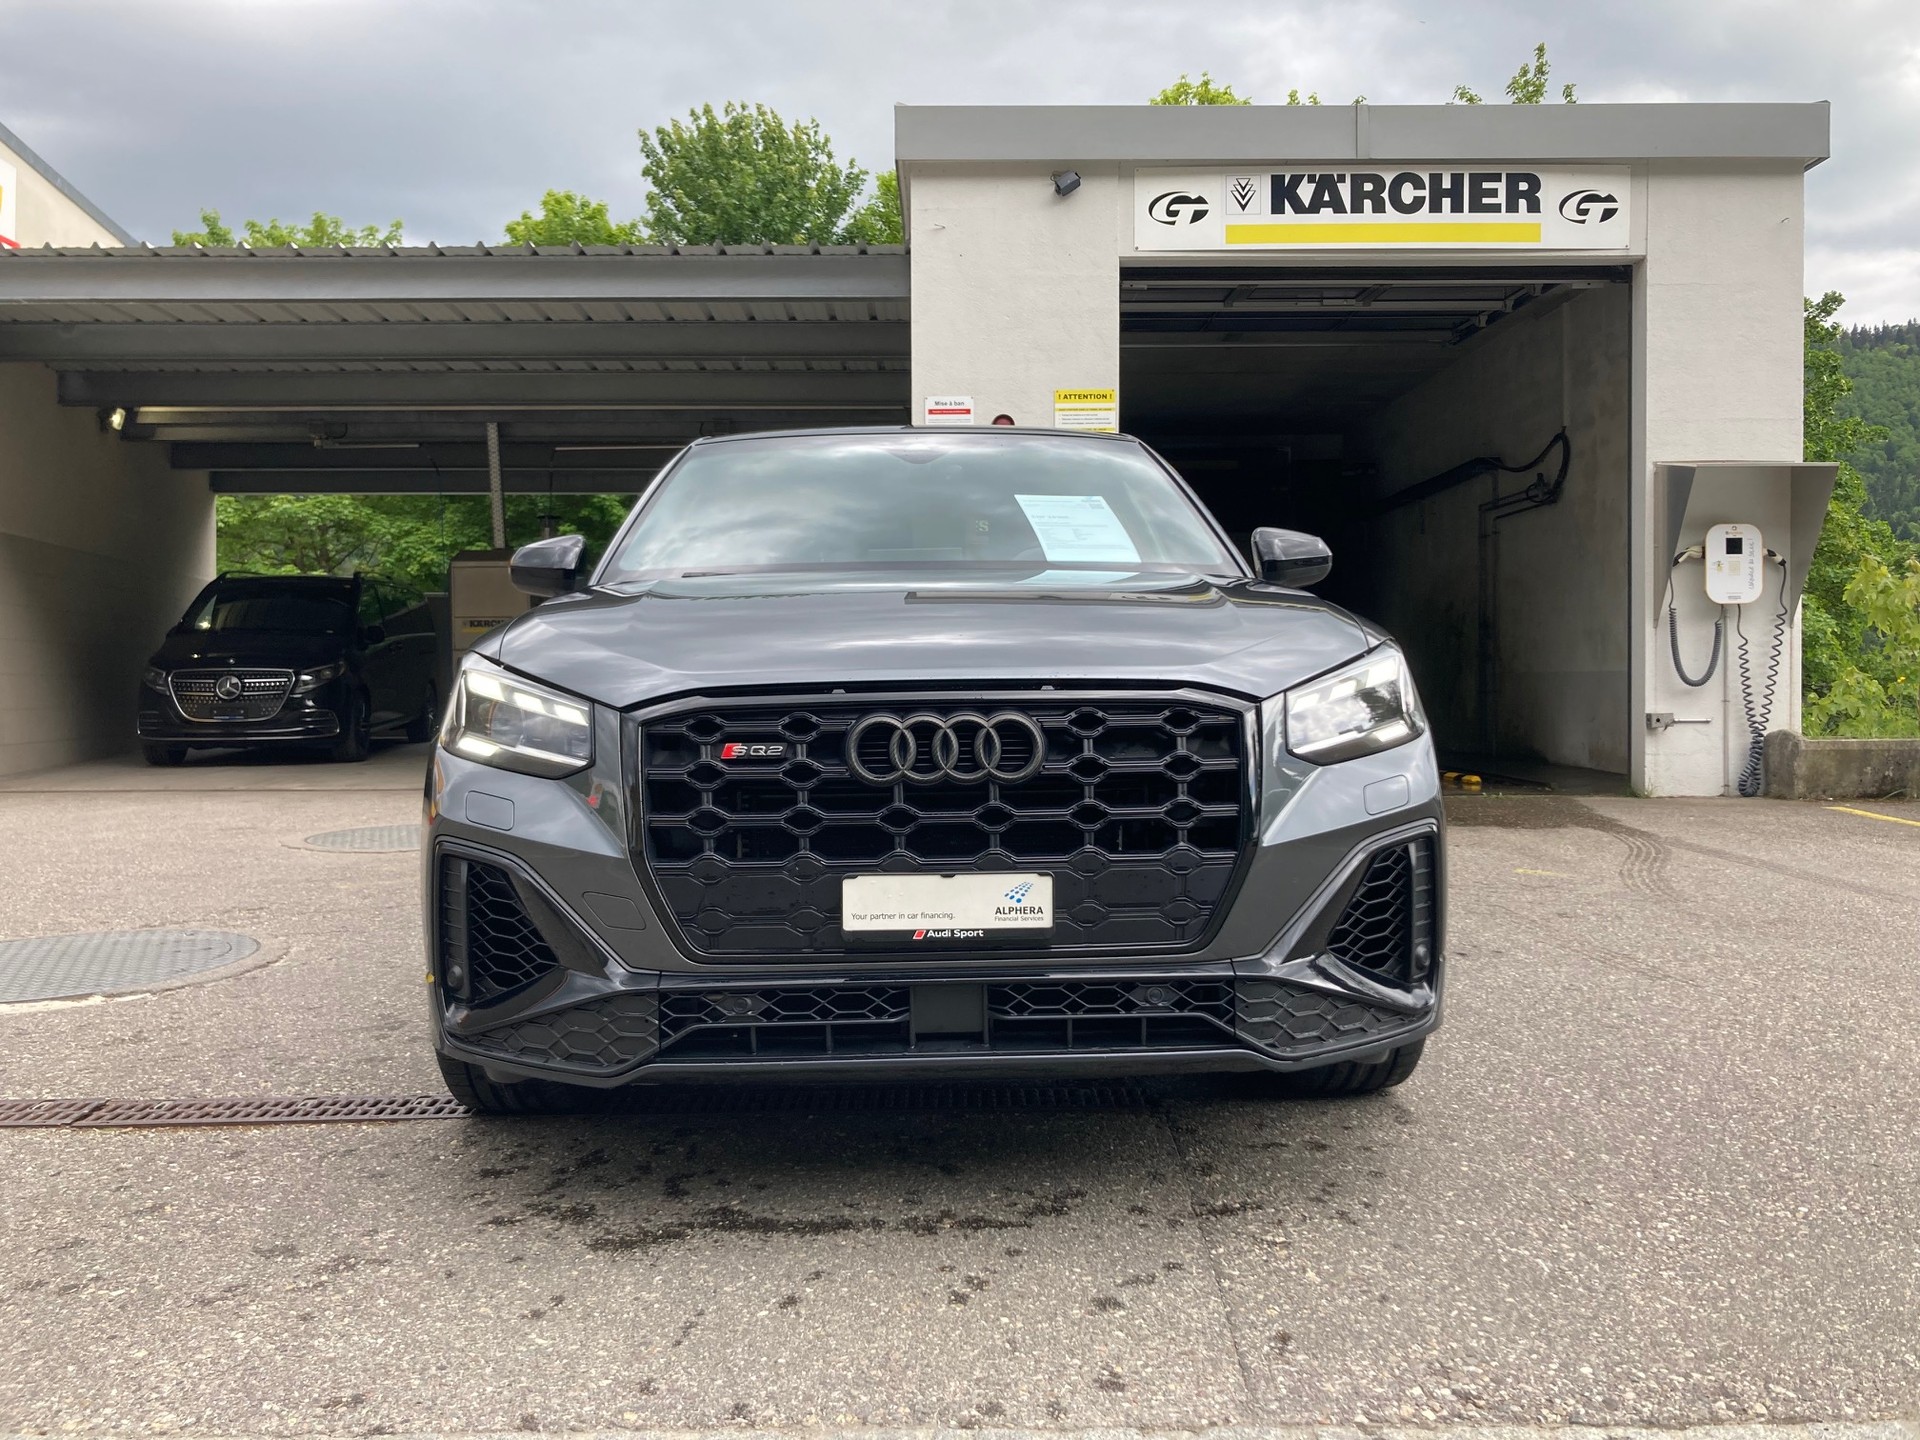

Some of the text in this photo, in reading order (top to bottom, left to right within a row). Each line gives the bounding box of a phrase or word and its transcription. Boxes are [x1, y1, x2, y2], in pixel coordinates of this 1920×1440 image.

[1269, 172, 1542, 215] KÄRCHER
[731, 745, 784, 756] SQ2
[994, 906, 1044, 915] ALPHERA
[851, 912, 868, 920] Your
[870, 913, 896, 922] partner
[898, 912, 906, 920] in
[920, 912, 956, 921] financing.
[926, 929, 984, 940] Audi Sport
